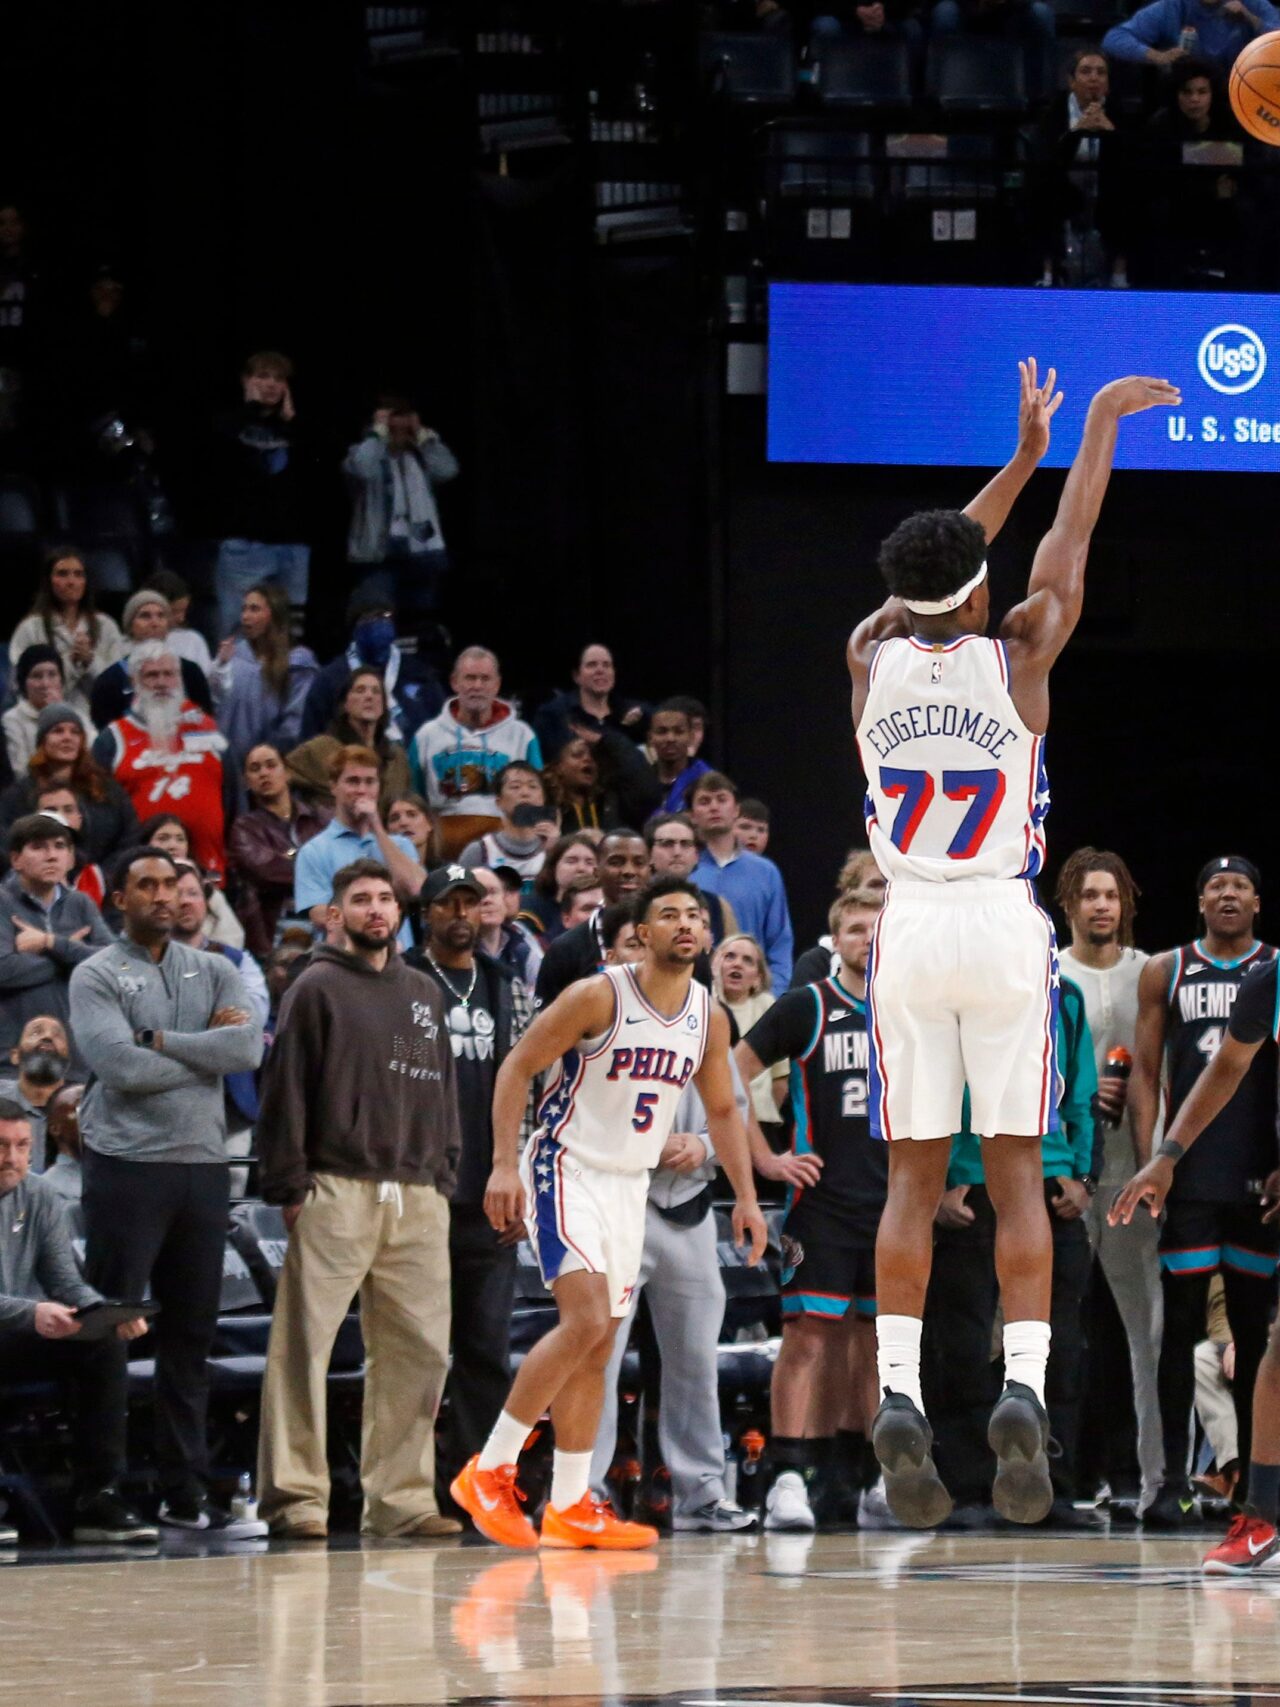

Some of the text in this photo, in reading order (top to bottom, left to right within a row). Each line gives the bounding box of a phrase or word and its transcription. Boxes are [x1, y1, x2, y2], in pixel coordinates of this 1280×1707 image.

[1168, 415, 1193, 442] U.
[1201, 416, 1226, 442] S.
[866, 704, 1018, 760] EDGECOMBE
[878, 765, 1007, 860] 77
[1179, 983, 1241, 1023] MEMP
[631, 1092, 659, 1134] 5
